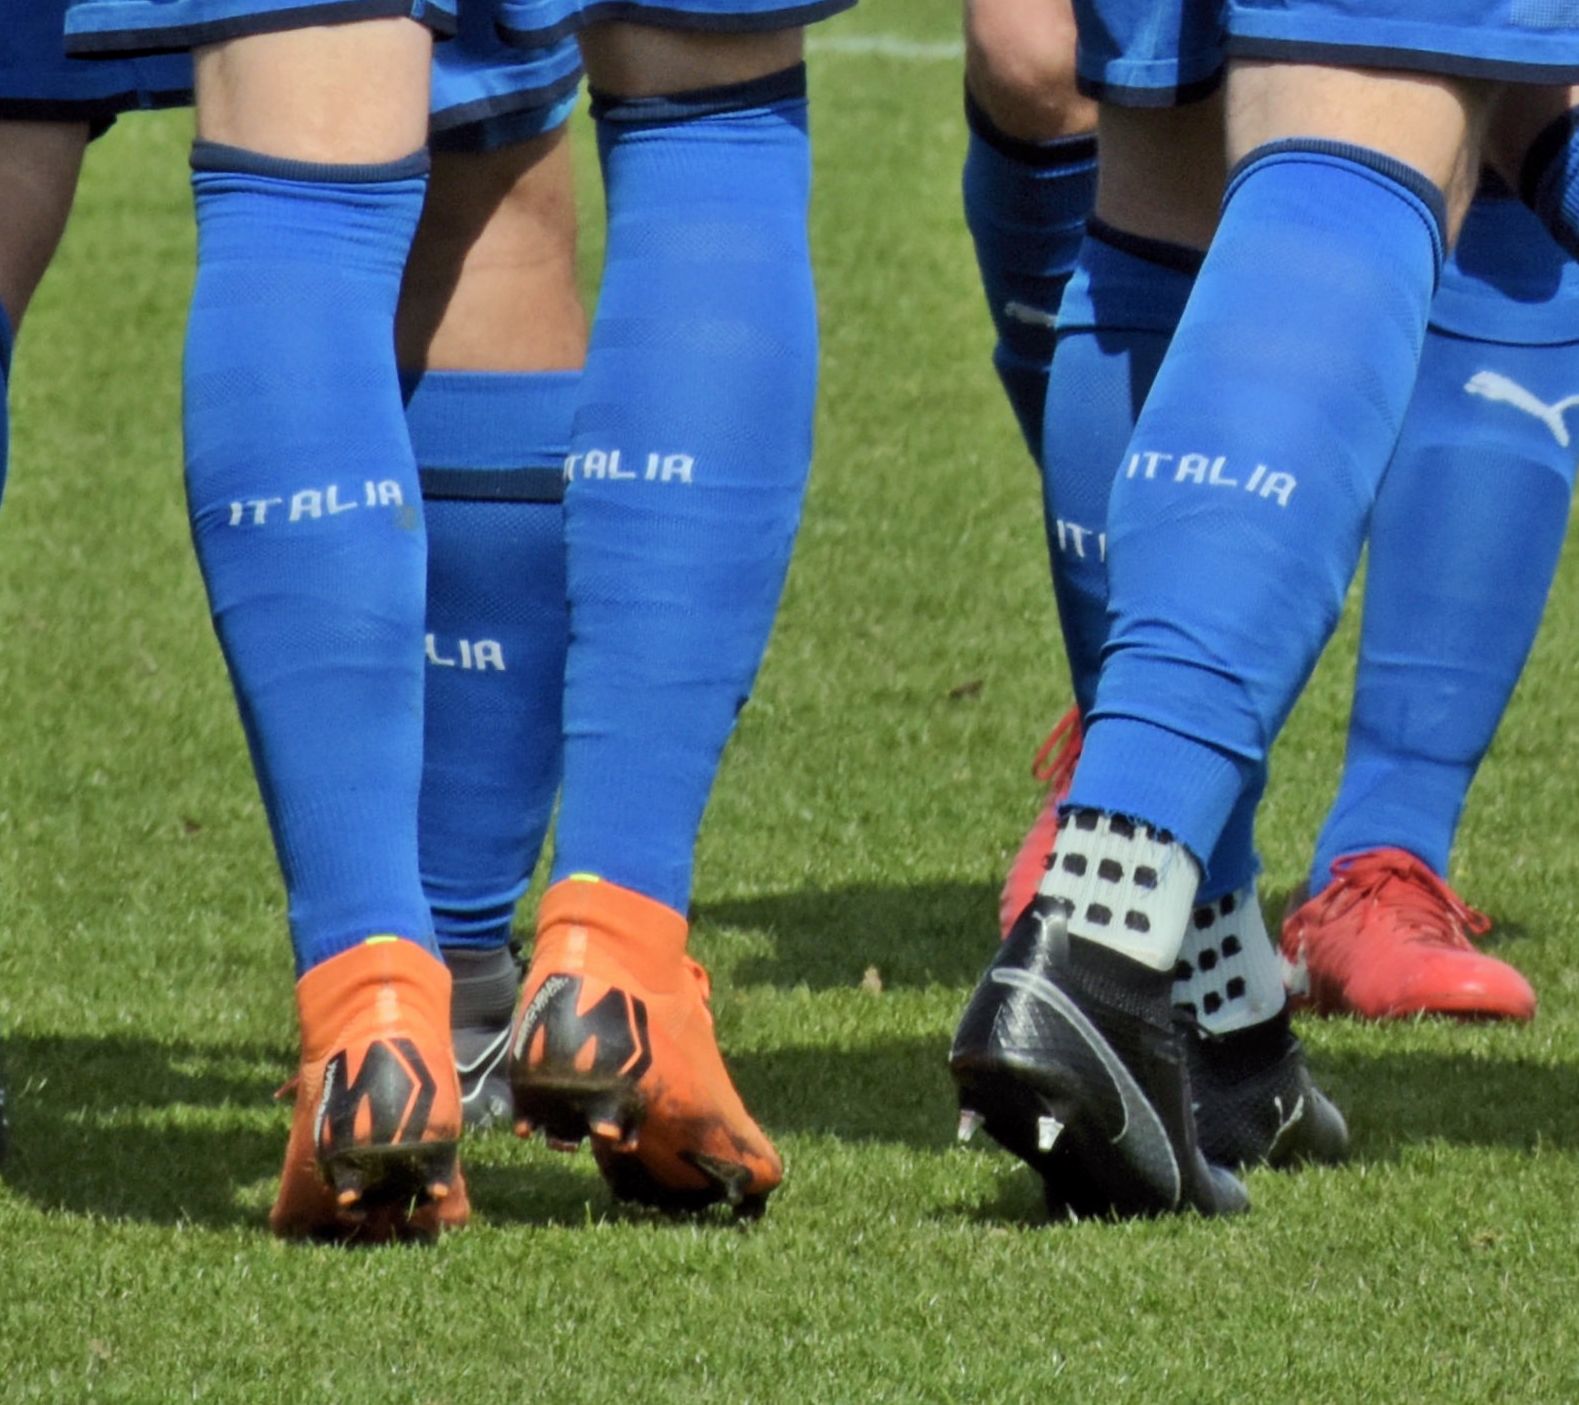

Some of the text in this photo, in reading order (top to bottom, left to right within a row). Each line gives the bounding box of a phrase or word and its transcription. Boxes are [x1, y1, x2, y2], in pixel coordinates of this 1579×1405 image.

[228, 479, 404, 527] ITALIA
[1125, 450, 1297, 508] ITALIA
[425, 632, 506, 671] LIA
